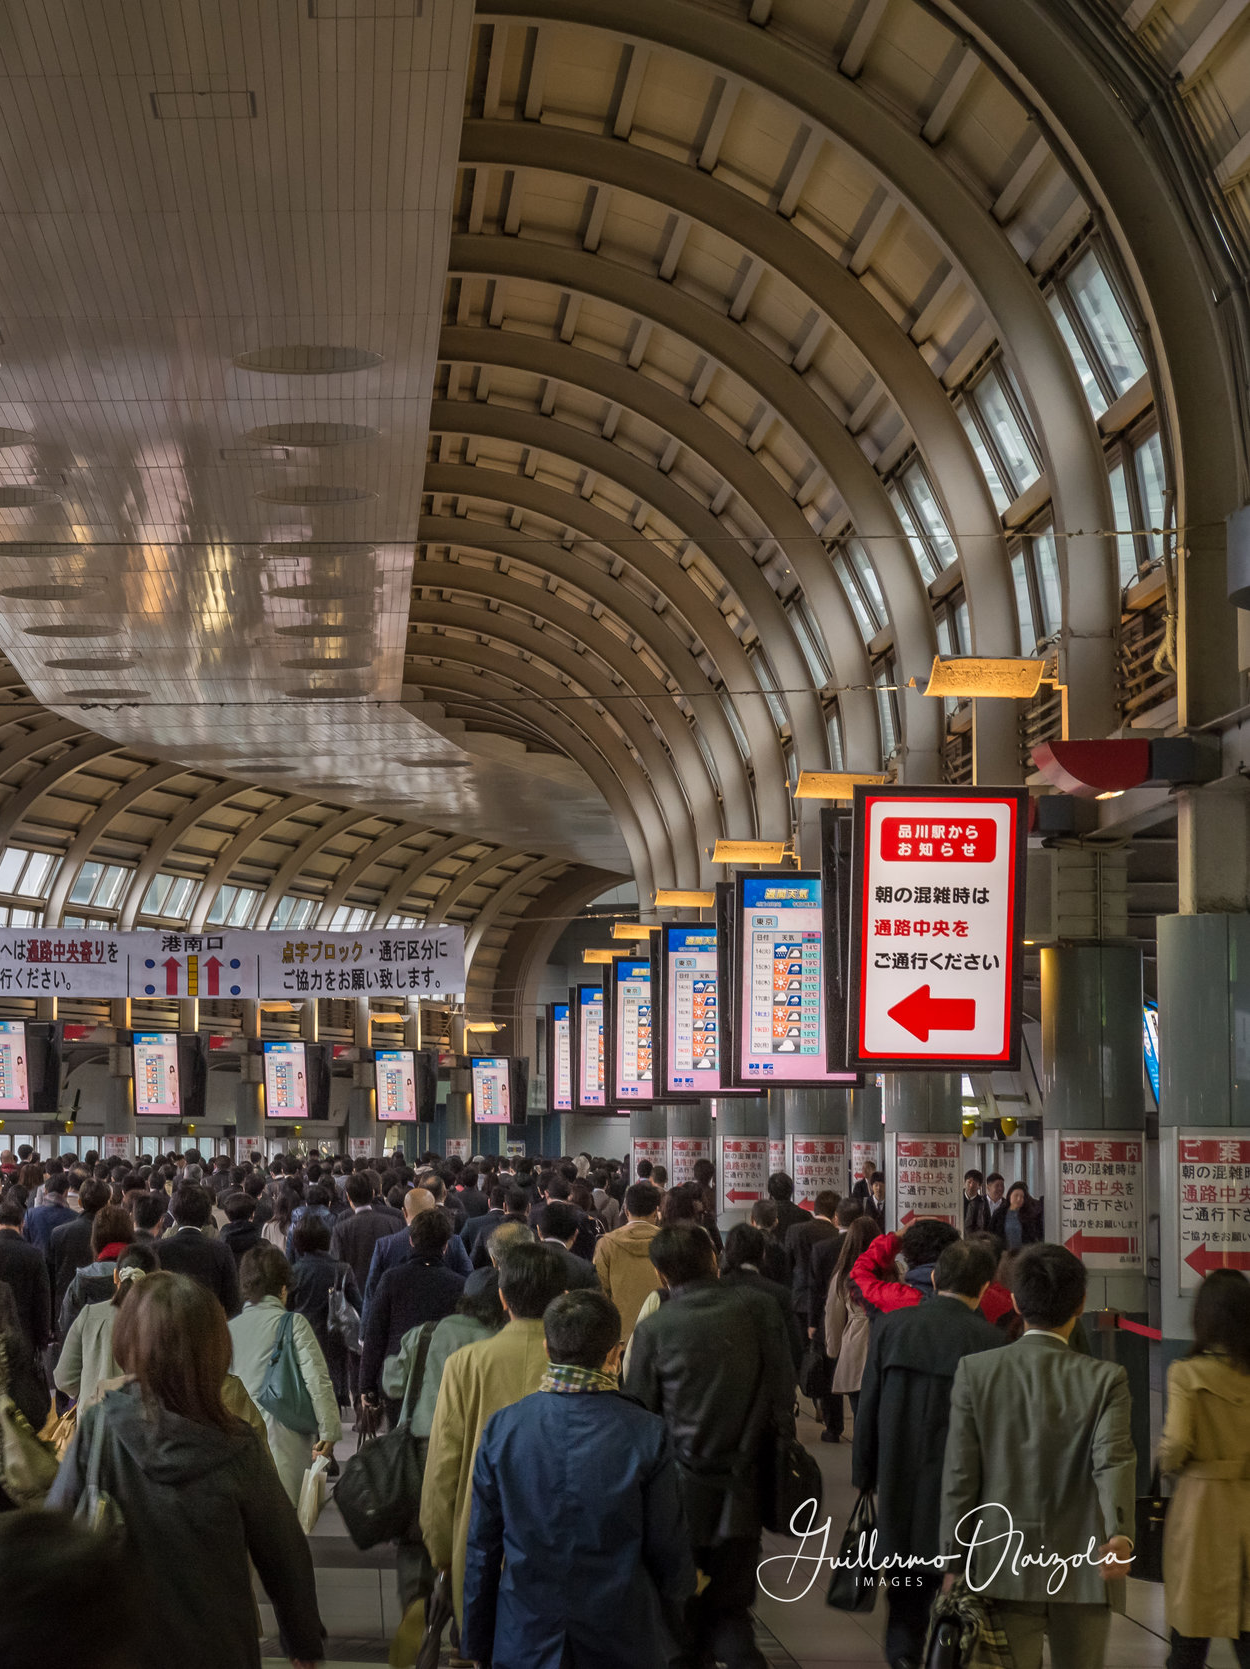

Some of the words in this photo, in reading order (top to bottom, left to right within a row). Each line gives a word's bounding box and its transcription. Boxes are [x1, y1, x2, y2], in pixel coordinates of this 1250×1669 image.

[898, 824, 979, 839] 品川駅から
[898, 842, 976, 857] お知らせ
[875, 886, 990, 905] 朝の混雑時は
[874, 919, 969, 937] 通路中央を
[161, 935, 224, 952] 港南口
[281, 939, 448, 963] 点字ブロック・通行区分に
[874, 952, 1000, 971] ご通行ください
[283, 966, 441, 990] ご協力をお願い致します。
[900, 1143, 957, 1156] ご案内
[1064, 1142, 1139, 1160] ご案内
[1184, 1140, 1241, 1162] ご案
[1062, 1163, 1136, 1175] 朝の混雑時は
[1063, 1179, 1134, 1196] 通路中央を
[1062, 1199, 1134, 1211] ご通行下さい
